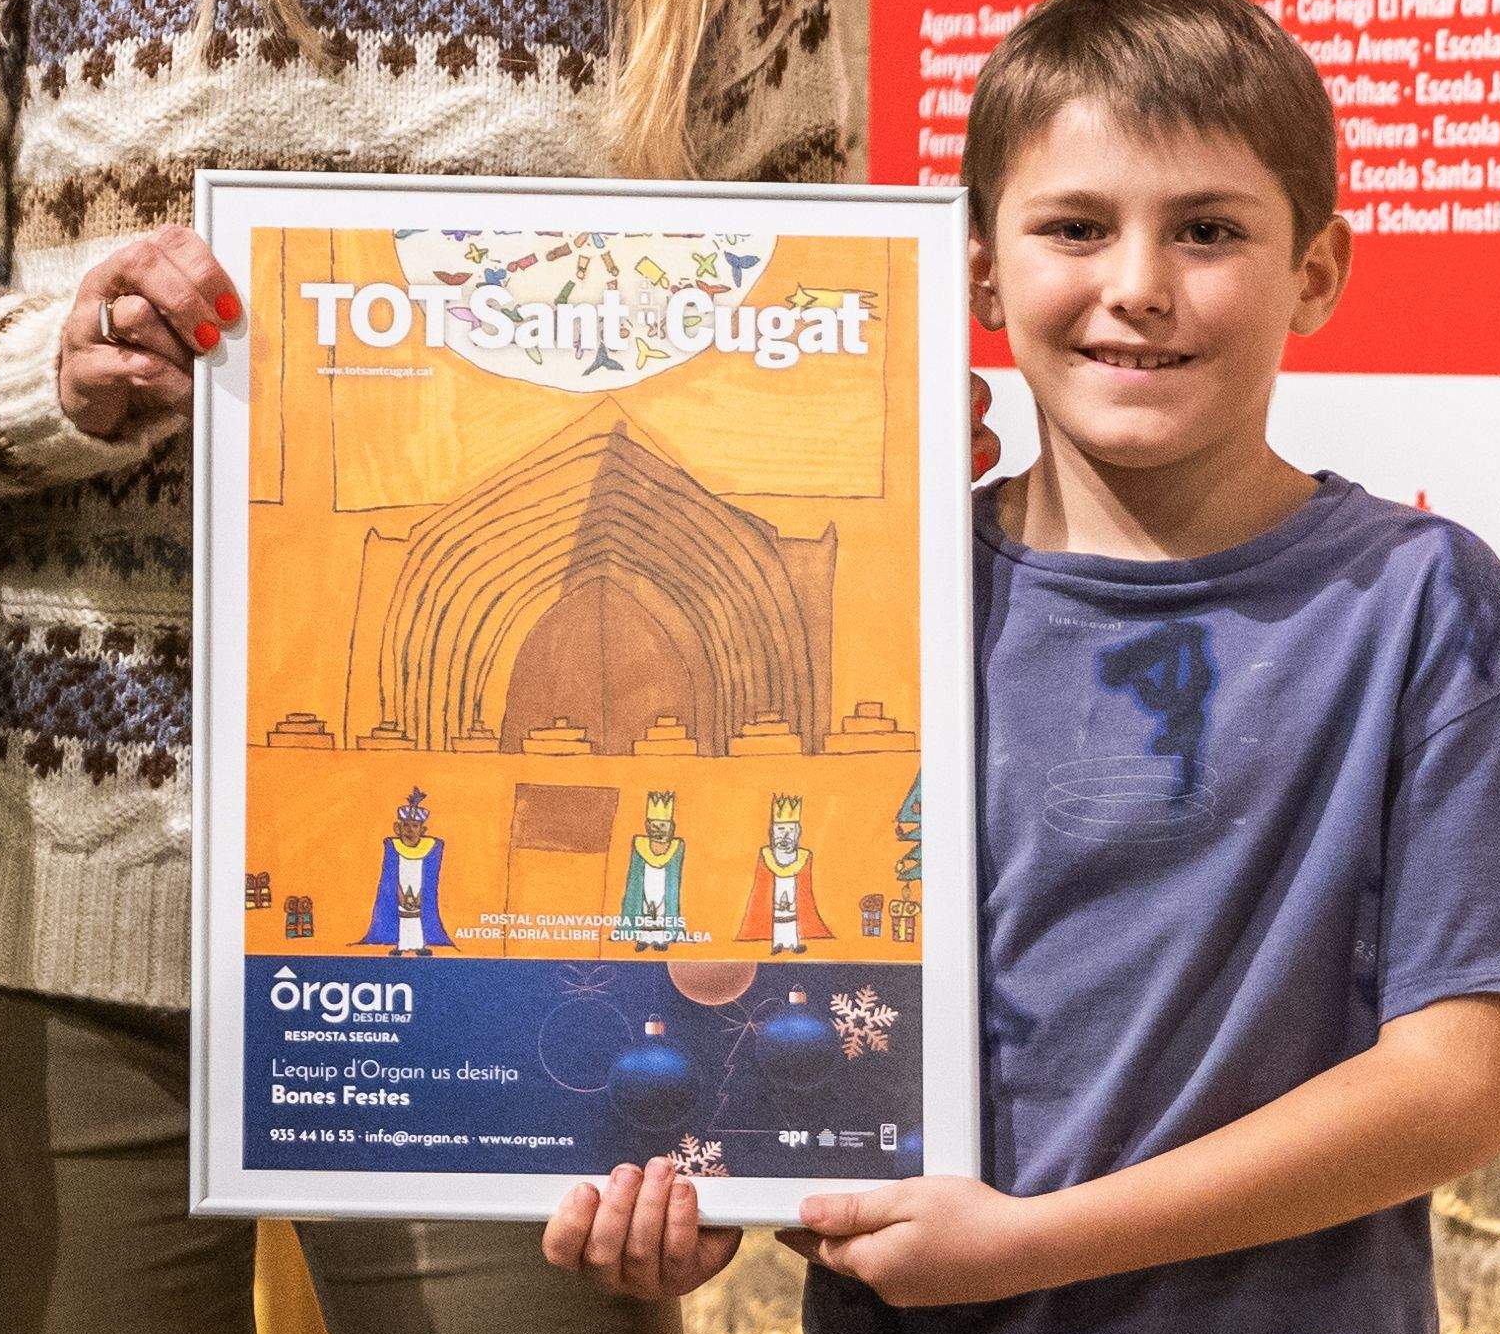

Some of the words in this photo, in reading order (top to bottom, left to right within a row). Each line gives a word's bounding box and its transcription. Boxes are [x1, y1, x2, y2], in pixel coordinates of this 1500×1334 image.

[1356, 32, 1420, 69] Avenç
[1414, 72, 1484, 105] Escola
[1433, 115, 1500, 147] Escola
[1350, 158, 1418, 191] Escola
[1421, 158, 1483, 190] Santa
[1377, 202, 1448, 233] School
[301, 283, 455, 348] TOT
[468, 286, 641, 351] Sant
[668, 288, 869, 367] Cugat
[480, 914, 532, 925] POSTAL
[537, 915, 633, 927] GUANYADORA
[635, 917, 652, 927] DE
[656, 917, 686, 928] REIS
[455, 928, 504, 939] AUTOR:
[553, 930, 599, 941] LLIBRE
[353, 1013, 373, 1022] DES
[391, 1013, 411, 1023] 1967
[284, 1031, 347, 1041] RESPOSTA
[349, 1031, 399, 1043] SEGURA
[272, 1059, 338, 1085] L'equip
[344, 1059, 424, 1083] d'Organ
[430, 1068, 451, 1080] us
[456, 1062, 518, 1085] desitja
[272, 1085, 336, 1105] Bones
[342, 1086, 409, 1106] Festes
[270, 1128, 295, 1142] 935
[299, 1129, 314, 1142] 44
[318, 1129, 332, 1143] 16
[337, 1130, 355, 1143] 55
[365, 1129, 469, 1146] info@organ.es
[479, 1133, 574, 1148] www.organ.es
